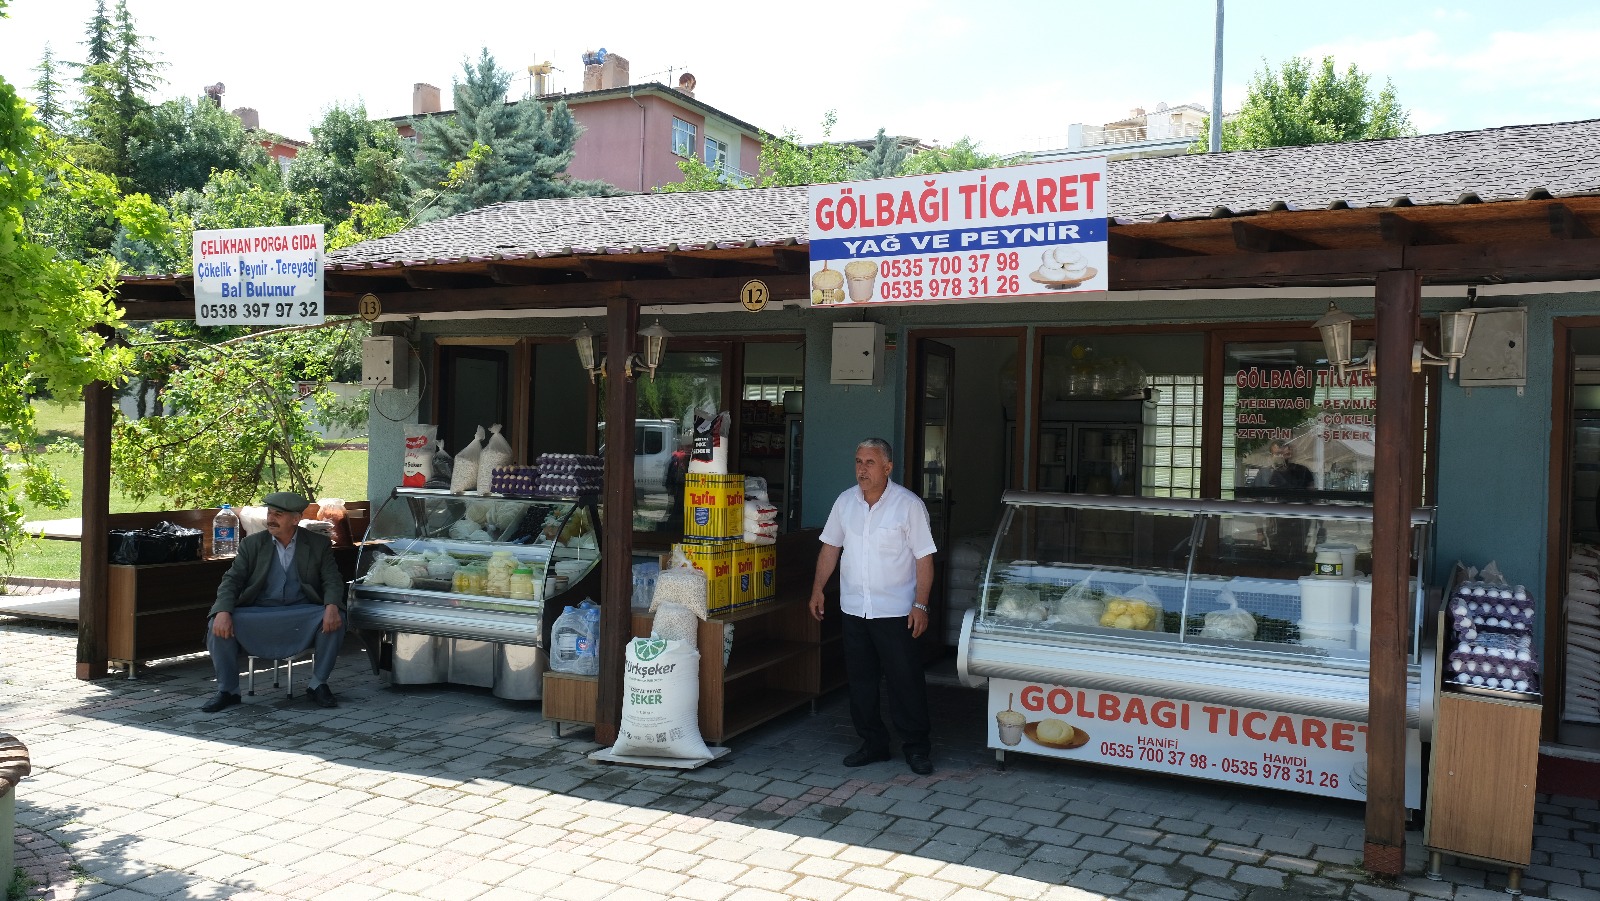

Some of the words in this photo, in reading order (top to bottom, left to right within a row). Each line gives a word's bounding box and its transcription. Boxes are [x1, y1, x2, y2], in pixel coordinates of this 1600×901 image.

[815, 180, 949, 231] GÖLBAĞI
[959, 172, 1101, 219] TİCARET
[200, 236, 251, 260] ÇELİKHAN
[255, 235, 289, 253] PORGA
[292, 233, 317, 250] GIDA
[842, 235, 901, 255] YAĞ
[910, 234, 950, 250] VE
[961, 223, 1081, 247] PEYNİR
[198, 261, 232, 282] Çökelik
[239, 260, 268, 280] Peynir
[880, 258, 923, 278] 0535
[928, 256, 962, 276] 700
[968, 253, 990, 273] 37
[996, 251, 1019, 271] 98
[221, 281, 242, 298] Bal
[246, 281, 296, 297] Bulunur
[746, 288, 763, 303] 12
[880, 279, 923, 299] 0535
[928, 277, 962, 297] 978
[968, 275, 988, 295] 31
[996, 274, 1020, 294] 26
[201, 303, 237, 319] 0538
[243, 303, 270, 318] 397
[275, 302, 294, 318] 97
[299, 301, 319, 317] 32
[363, 301, 377, 314] 13
[1235, 366, 1313, 389] GÖLBAĞI
[631, 692, 662, 706] ŞEKER
[1137, 735, 1179, 749] HANİFİ
[1101, 741, 1134, 759] 0535
[1138, 747, 1164, 763] 700
[1167, 750, 1186, 766] 37
[1189, 753, 1208, 769] 98
[1221, 757, 1258, 777] 0535
[1262, 763, 1291, 781] 978
[1295, 768, 1315, 786] 31
[1319, 771, 1339, 789] 26
[1263, 752, 1307, 767] HAMDİ
